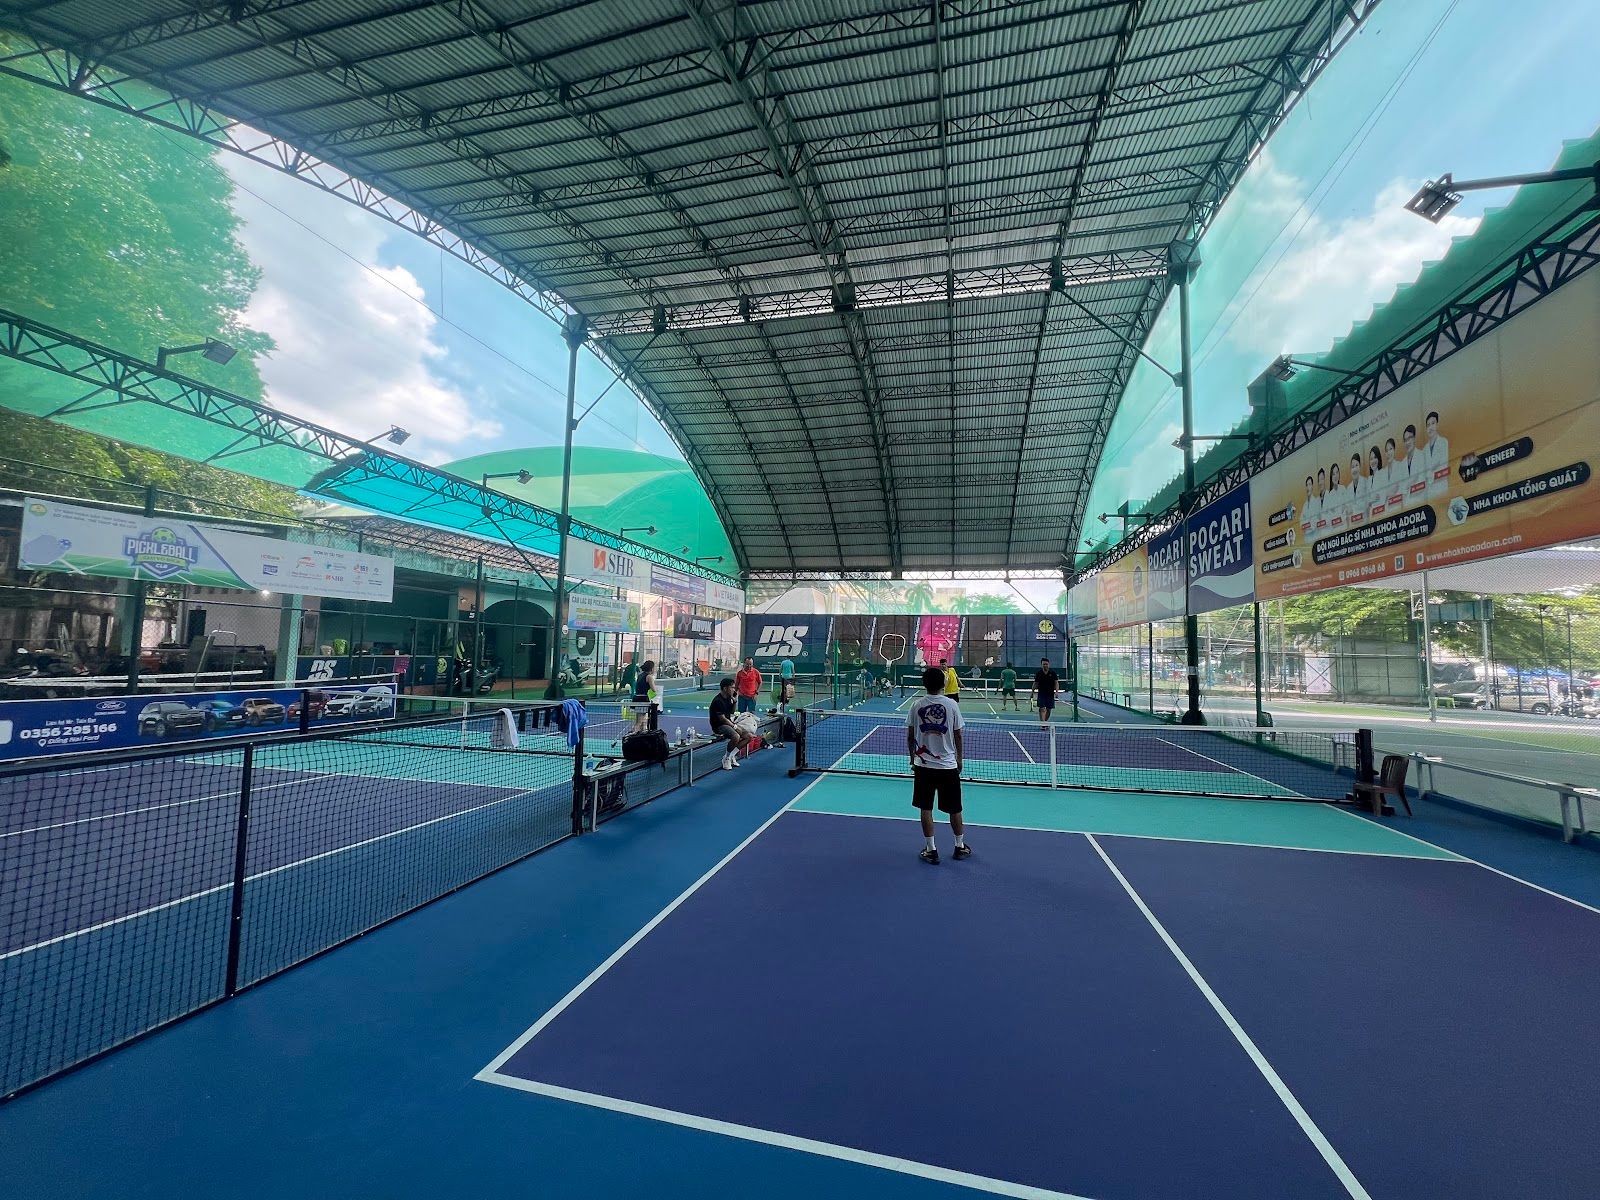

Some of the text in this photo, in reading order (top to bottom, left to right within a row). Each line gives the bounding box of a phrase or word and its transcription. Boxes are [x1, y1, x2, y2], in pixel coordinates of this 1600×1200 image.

[1485, 447, 1516, 466] VENEER
[1473, 470, 1578, 511] NHA KHOA TỔNG QUÁT
[1189, 502, 1250, 555] POCARI
[1316, 542, 1327, 553] ĐỘI
[1340, 533, 1354, 546] BÁC
[1361, 528, 1376, 540] NHA
[1376, 521, 1397, 535] KHOA
[1398, 510, 1427, 528] ADORA
[127, 539, 196, 562] PICKLEBALL
[1149, 536, 1184, 567] POCARI
[1189, 534, 1244, 578] SWEAT
[1425, 534, 1522, 563] www.nhakhoaadora.com
[607, 552, 634, 578] SHB
[1149, 561, 1181, 590] SWEAT
[1377, 563, 1386, 573] 68
[20, 723, 118, 739] 0356 295 166
[83, 734, 100, 742] Ford
